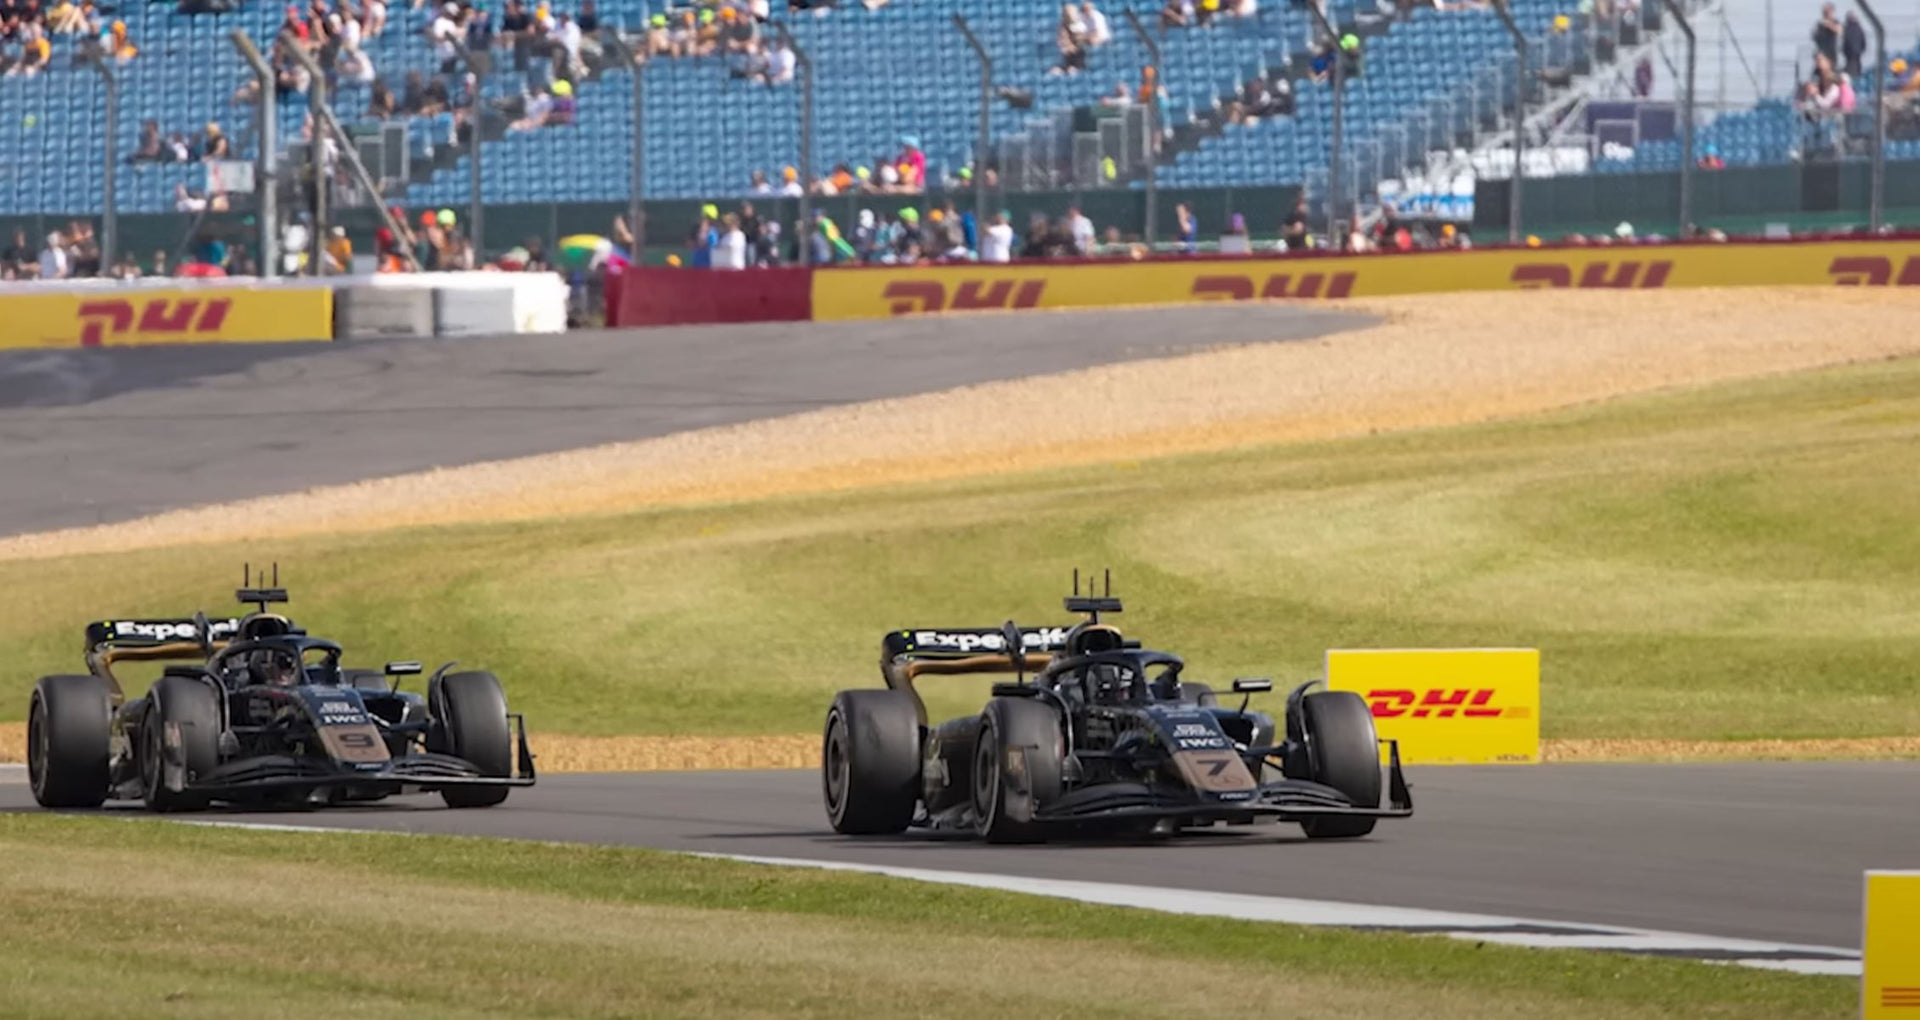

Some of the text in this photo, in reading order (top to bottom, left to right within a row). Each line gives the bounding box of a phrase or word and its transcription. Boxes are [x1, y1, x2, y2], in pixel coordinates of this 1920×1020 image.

[1366, 689, 1503, 718] DHL
[339, 733, 375, 748] 9
[1197, 760, 1231, 776] 7
